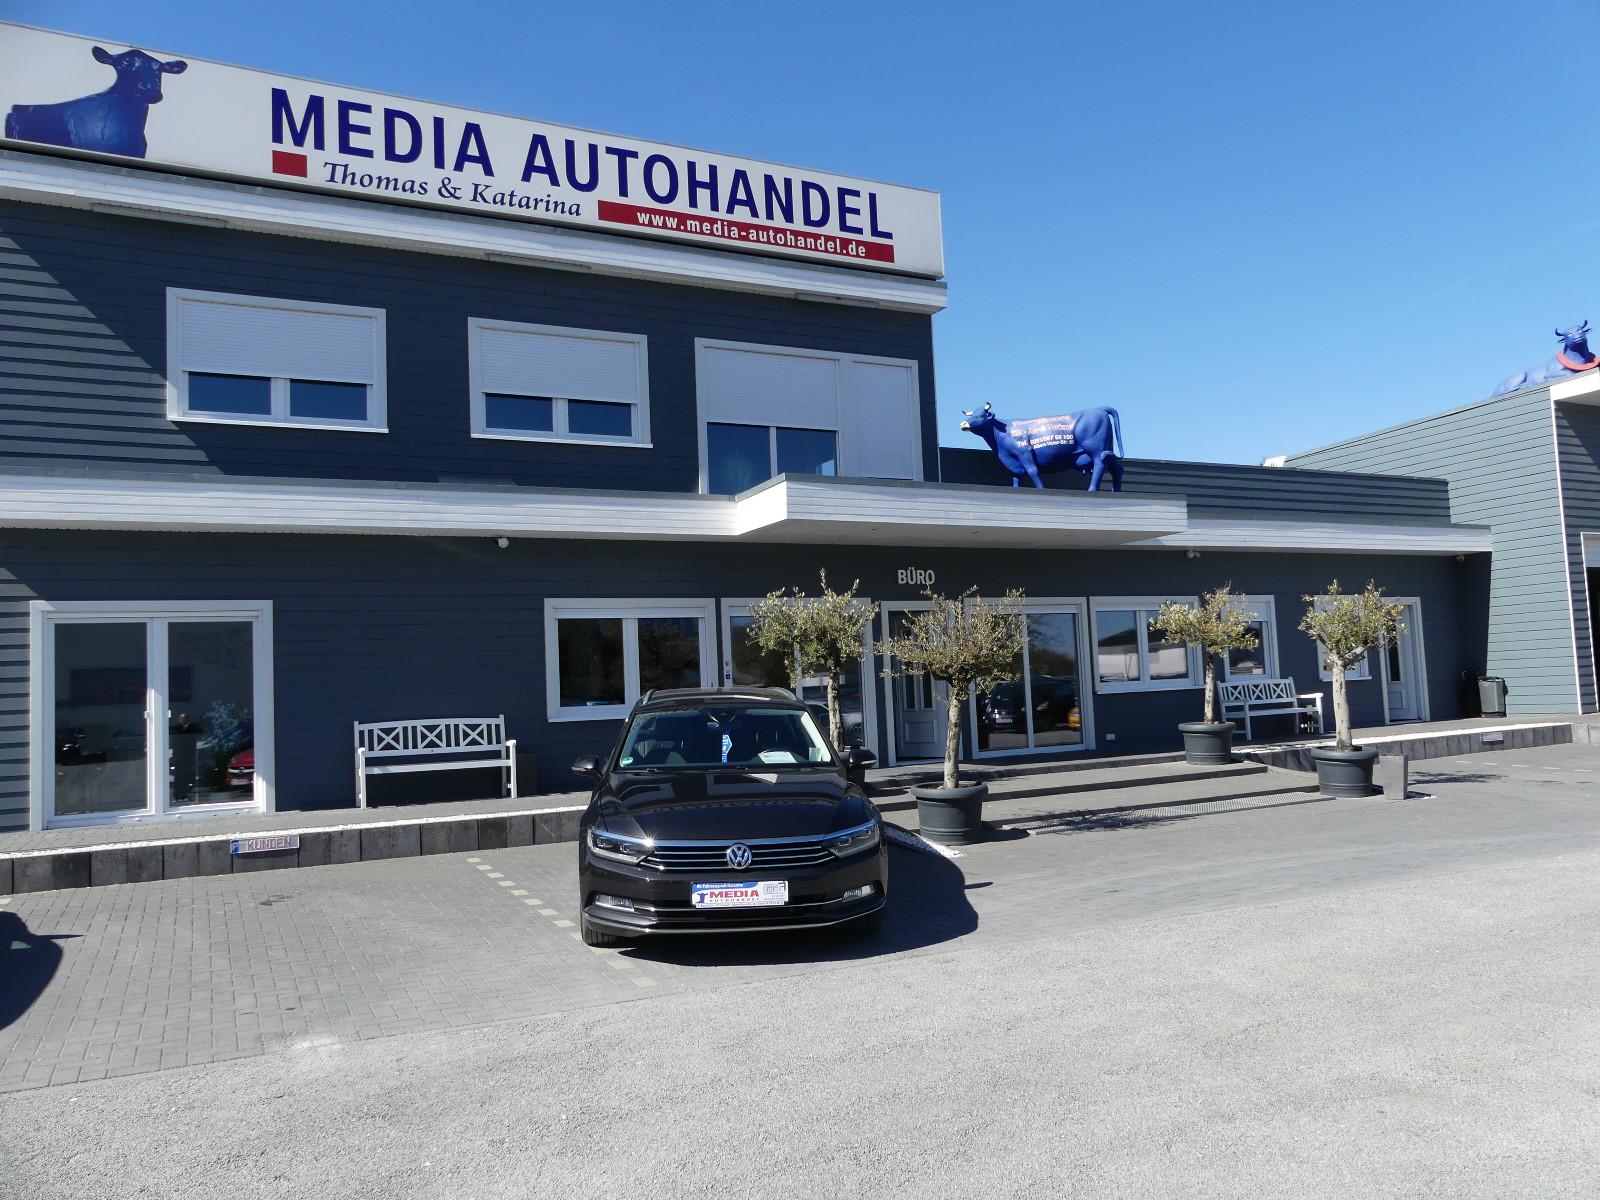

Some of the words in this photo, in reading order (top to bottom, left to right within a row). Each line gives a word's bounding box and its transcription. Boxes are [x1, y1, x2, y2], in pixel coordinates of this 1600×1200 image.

[271, 87, 495, 178] MEDIA
[520, 133, 894, 240] AUTOHANDEL
[323, 160, 429, 196] Thomas
[437, 176, 464, 200] &
[470, 182, 582, 217] Katarina
[636, 211, 867, 257] www.media-autohandel.de
[897, 566, 936, 585] BÜRO
[248, 836, 291, 851] KUNDEN
[709, 889, 760, 899] MEDIA
